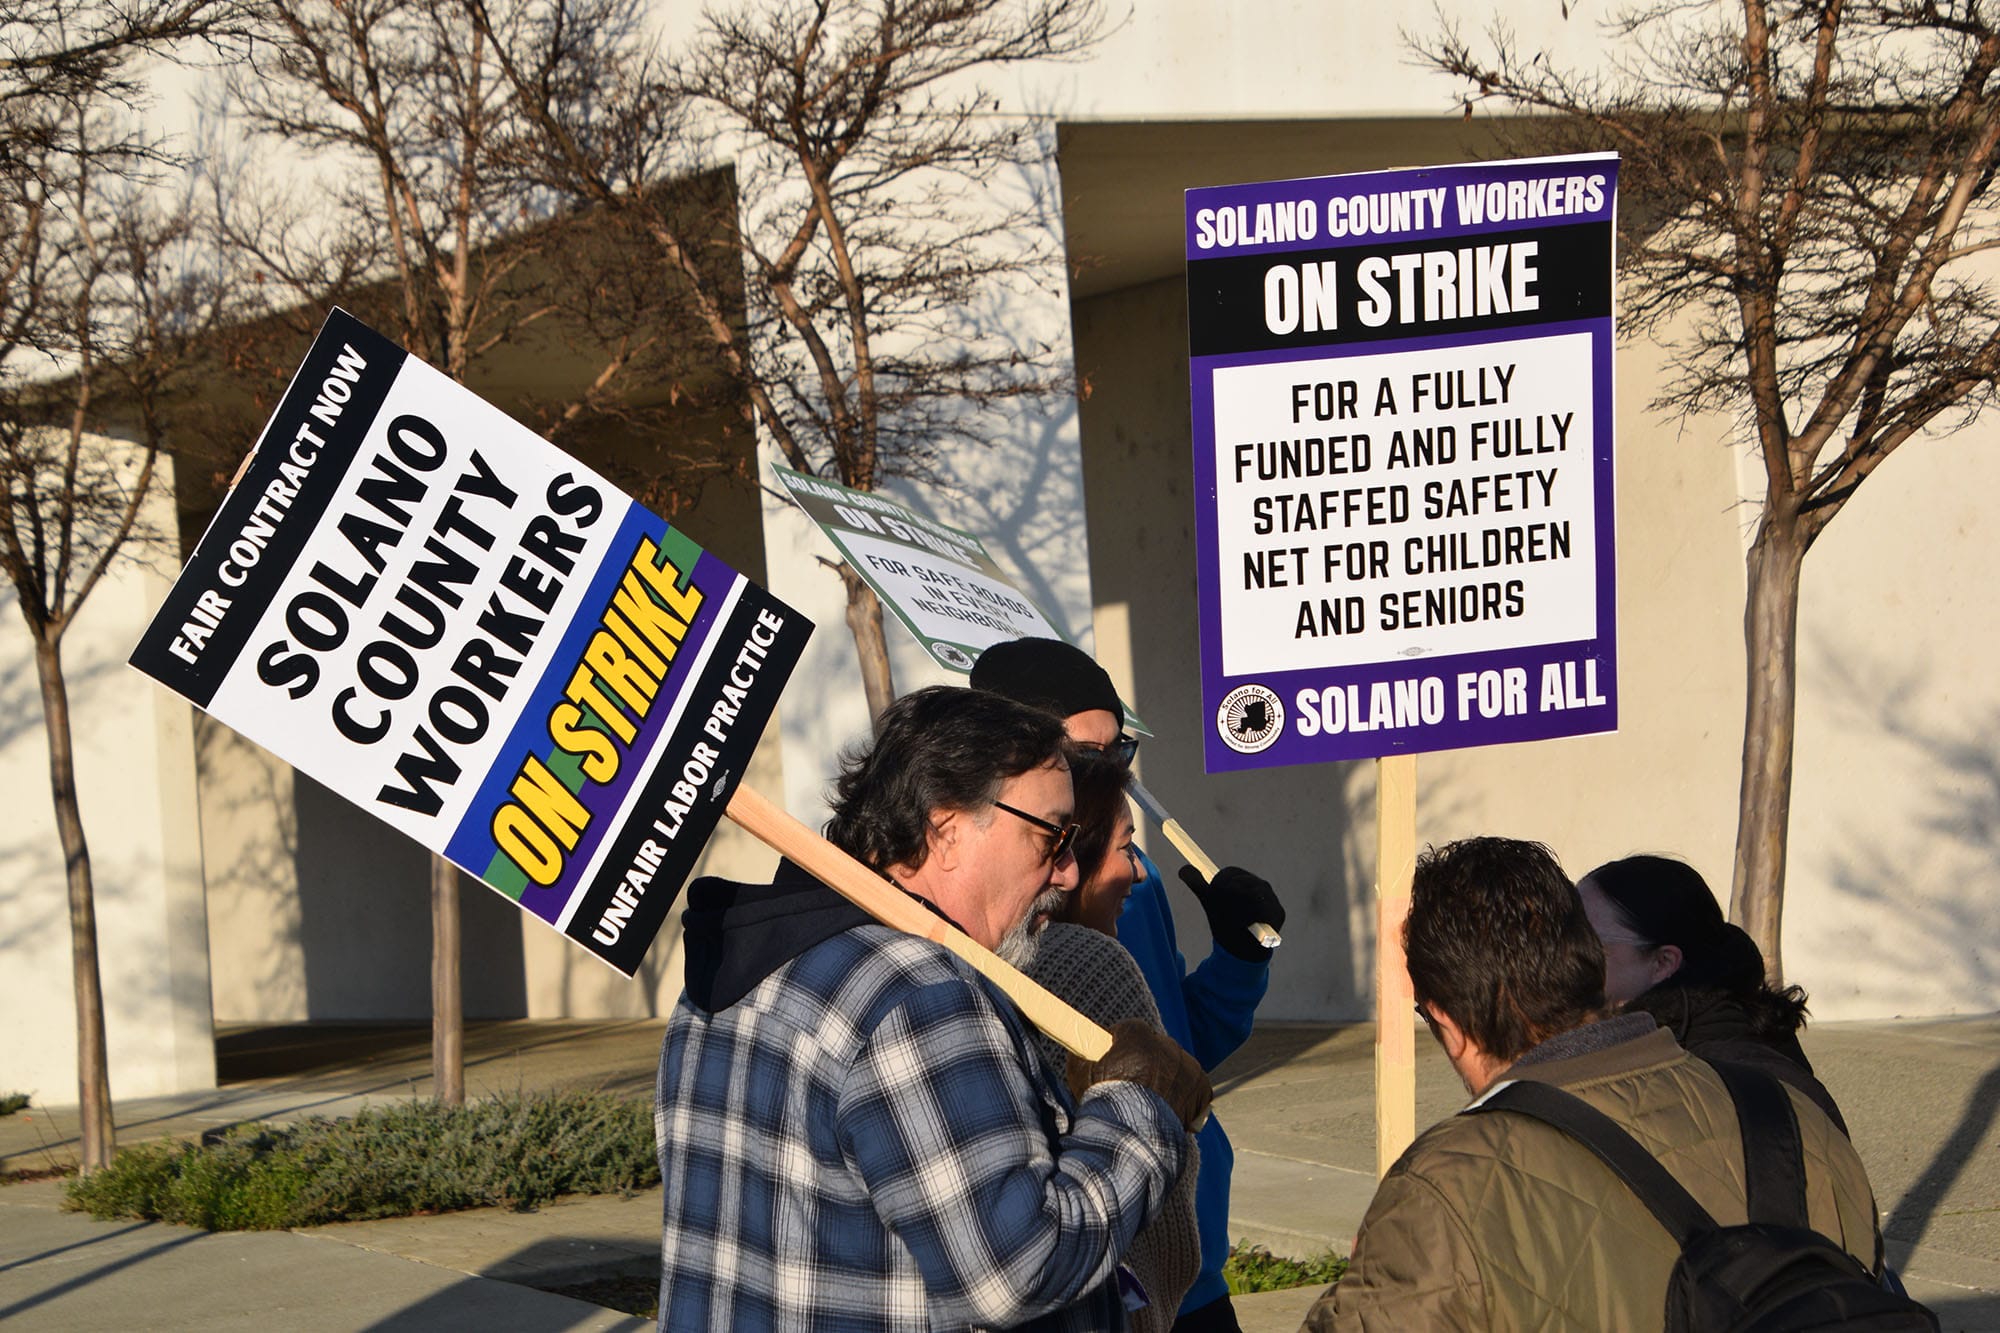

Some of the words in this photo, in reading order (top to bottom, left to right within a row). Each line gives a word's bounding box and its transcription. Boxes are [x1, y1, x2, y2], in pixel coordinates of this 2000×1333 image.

[1196, 200, 1317, 250] SOLANO
[1328, 188, 1447, 238] COUNTY
[1456, 174, 1606, 226] WORKERS
[1264, 261, 1338, 335] ON
[1356, 240, 1540, 327] STRIKE
[1292, 381, 1358, 424] FOR
[1375, 377, 1397, 417] A
[1413, 364, 1516, 413] FULLY
[1235, 435, 1371, 483] FUNDED
[1387, 426, 1456, 470] AND
[1472, 412, 1574, 461] FULLY
[169, 590, 232, 664] FAIR
[219, 422, 326, 587] CONTRACT
[310, 342, 366, 427] NOW
[781, 472, 849, 503] SOLANO
[847, 492, 912, 521] COUNTY
[1253, 485, 1409, 535] STAFFED
[1424, 468, 1558, 520] SAFETY
[257, 414, 448, 700] SOLANO
[833, 504, 887, 535] ON
[880, 516, 983, 571] STRIKE
[1244, 548, 1309, 590] NET
[1324, 541, 1389, 583] FOR
[1404, 521, 1570, 576] CHILDREN
[332, 449, 518, 745] COUNTY
[865, 554, 911, 578] FOR
[912, 565, 970, 593] SAFE
[968, 582, 1034, 619] ROADS
[922, 584, 948, 603] IN
[949, 590, 1015, 625] EVERY
[1295, 596, 1365, 639] AND
[1380, 580, 1524, 631] SENIORS
[376, 472, 603, 817] WORKERS
[492, 755, 592, 887] ON
[549, 537, 704, 785] STRIKE
[1222, 688, 1249, 710] Solano
[1252, 687, 1265, 695] for
[1266, 693, 1278, 705] All
[1295, 677, 1445, 737] SOLANO
[1457, 668, 1528, 722] FOR
[1539, 659, 1607, 712] ALL
[592, 839, 668, 946] UNFAIR
[653, 741, 720, 840] LABOR
[703, 608, 784, 743] PRACTICE
